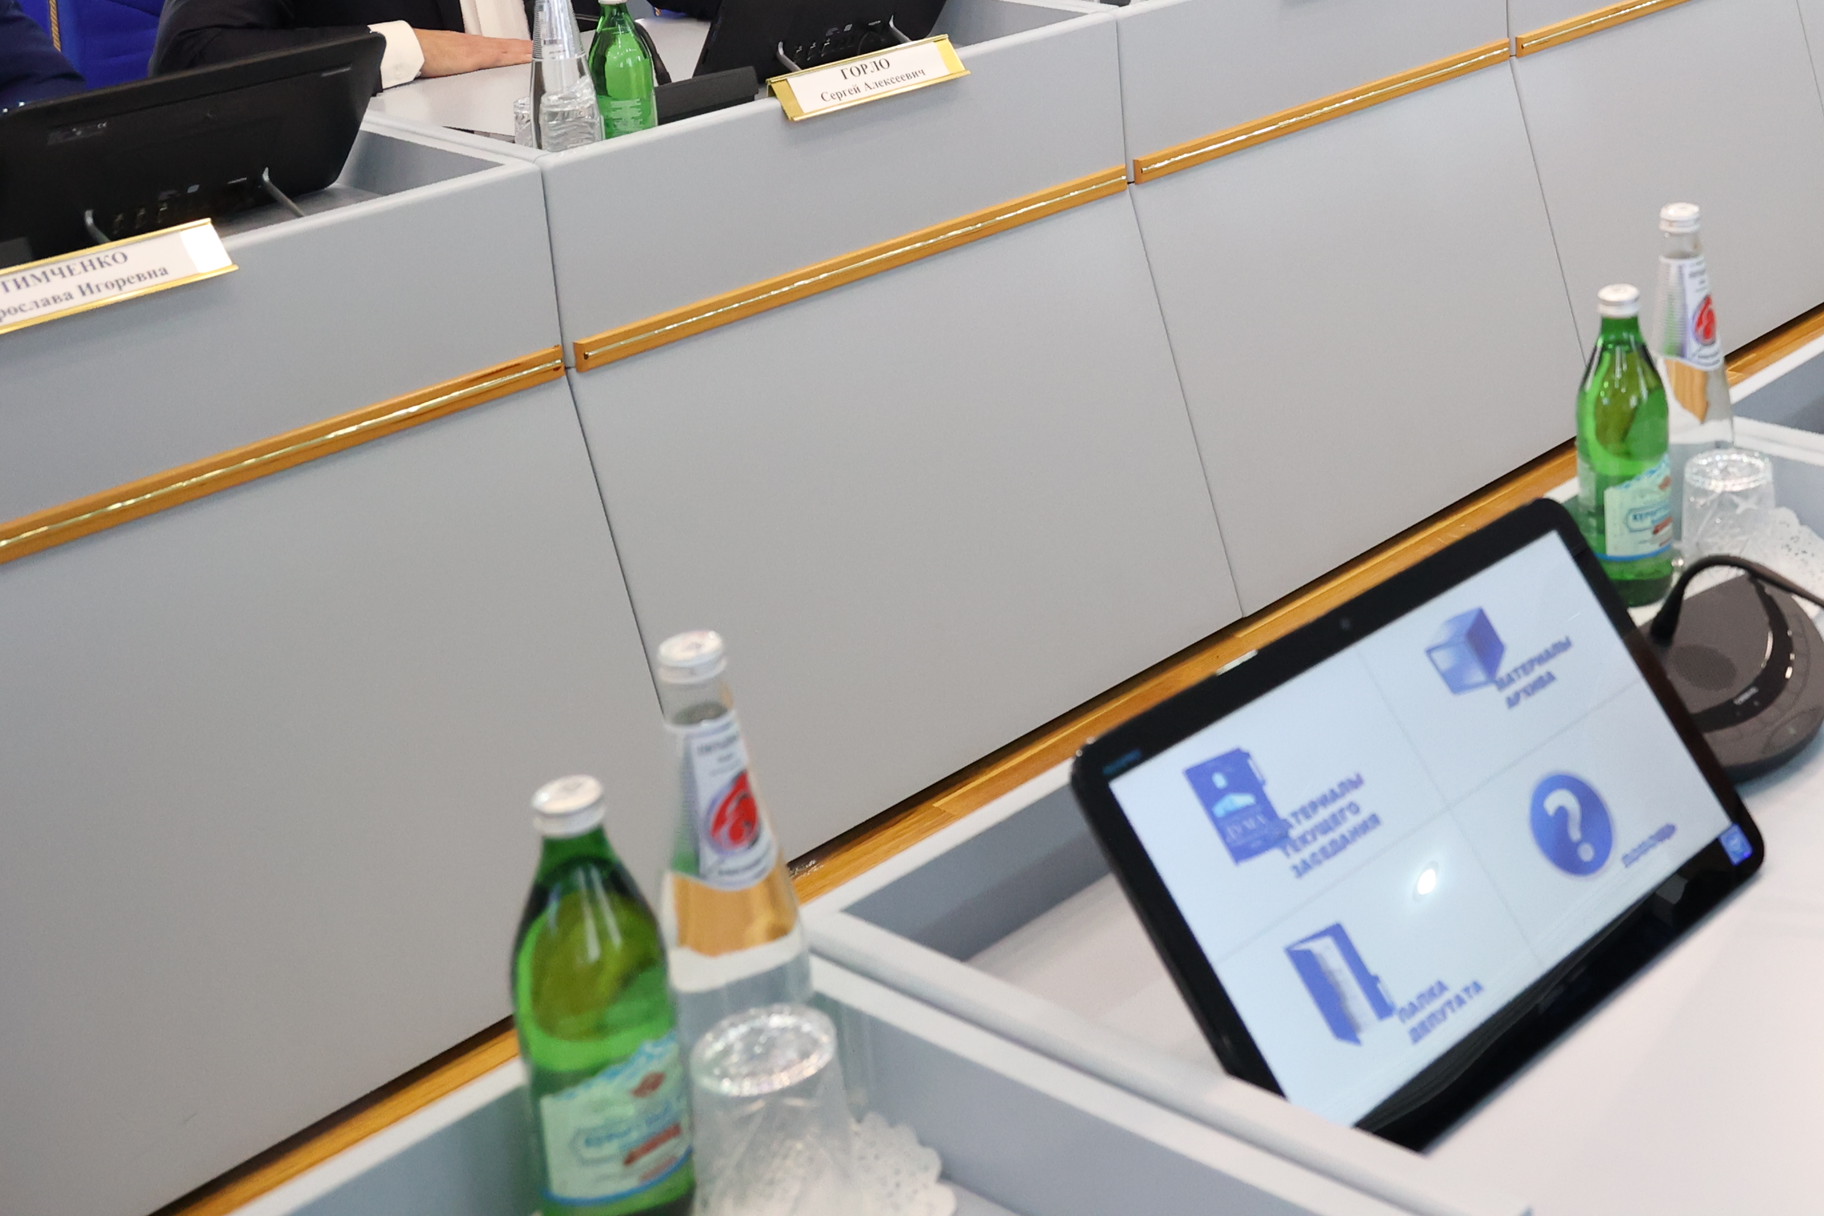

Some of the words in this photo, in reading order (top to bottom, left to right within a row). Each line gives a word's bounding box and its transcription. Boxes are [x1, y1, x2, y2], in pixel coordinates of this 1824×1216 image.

[820, 84, 861, 103] Сергей
[863, 68, 926, 92] Алексеевич
[840, 57, 891, 81] ГОРЛО
[78, 265, 170, 298] Игоревна
